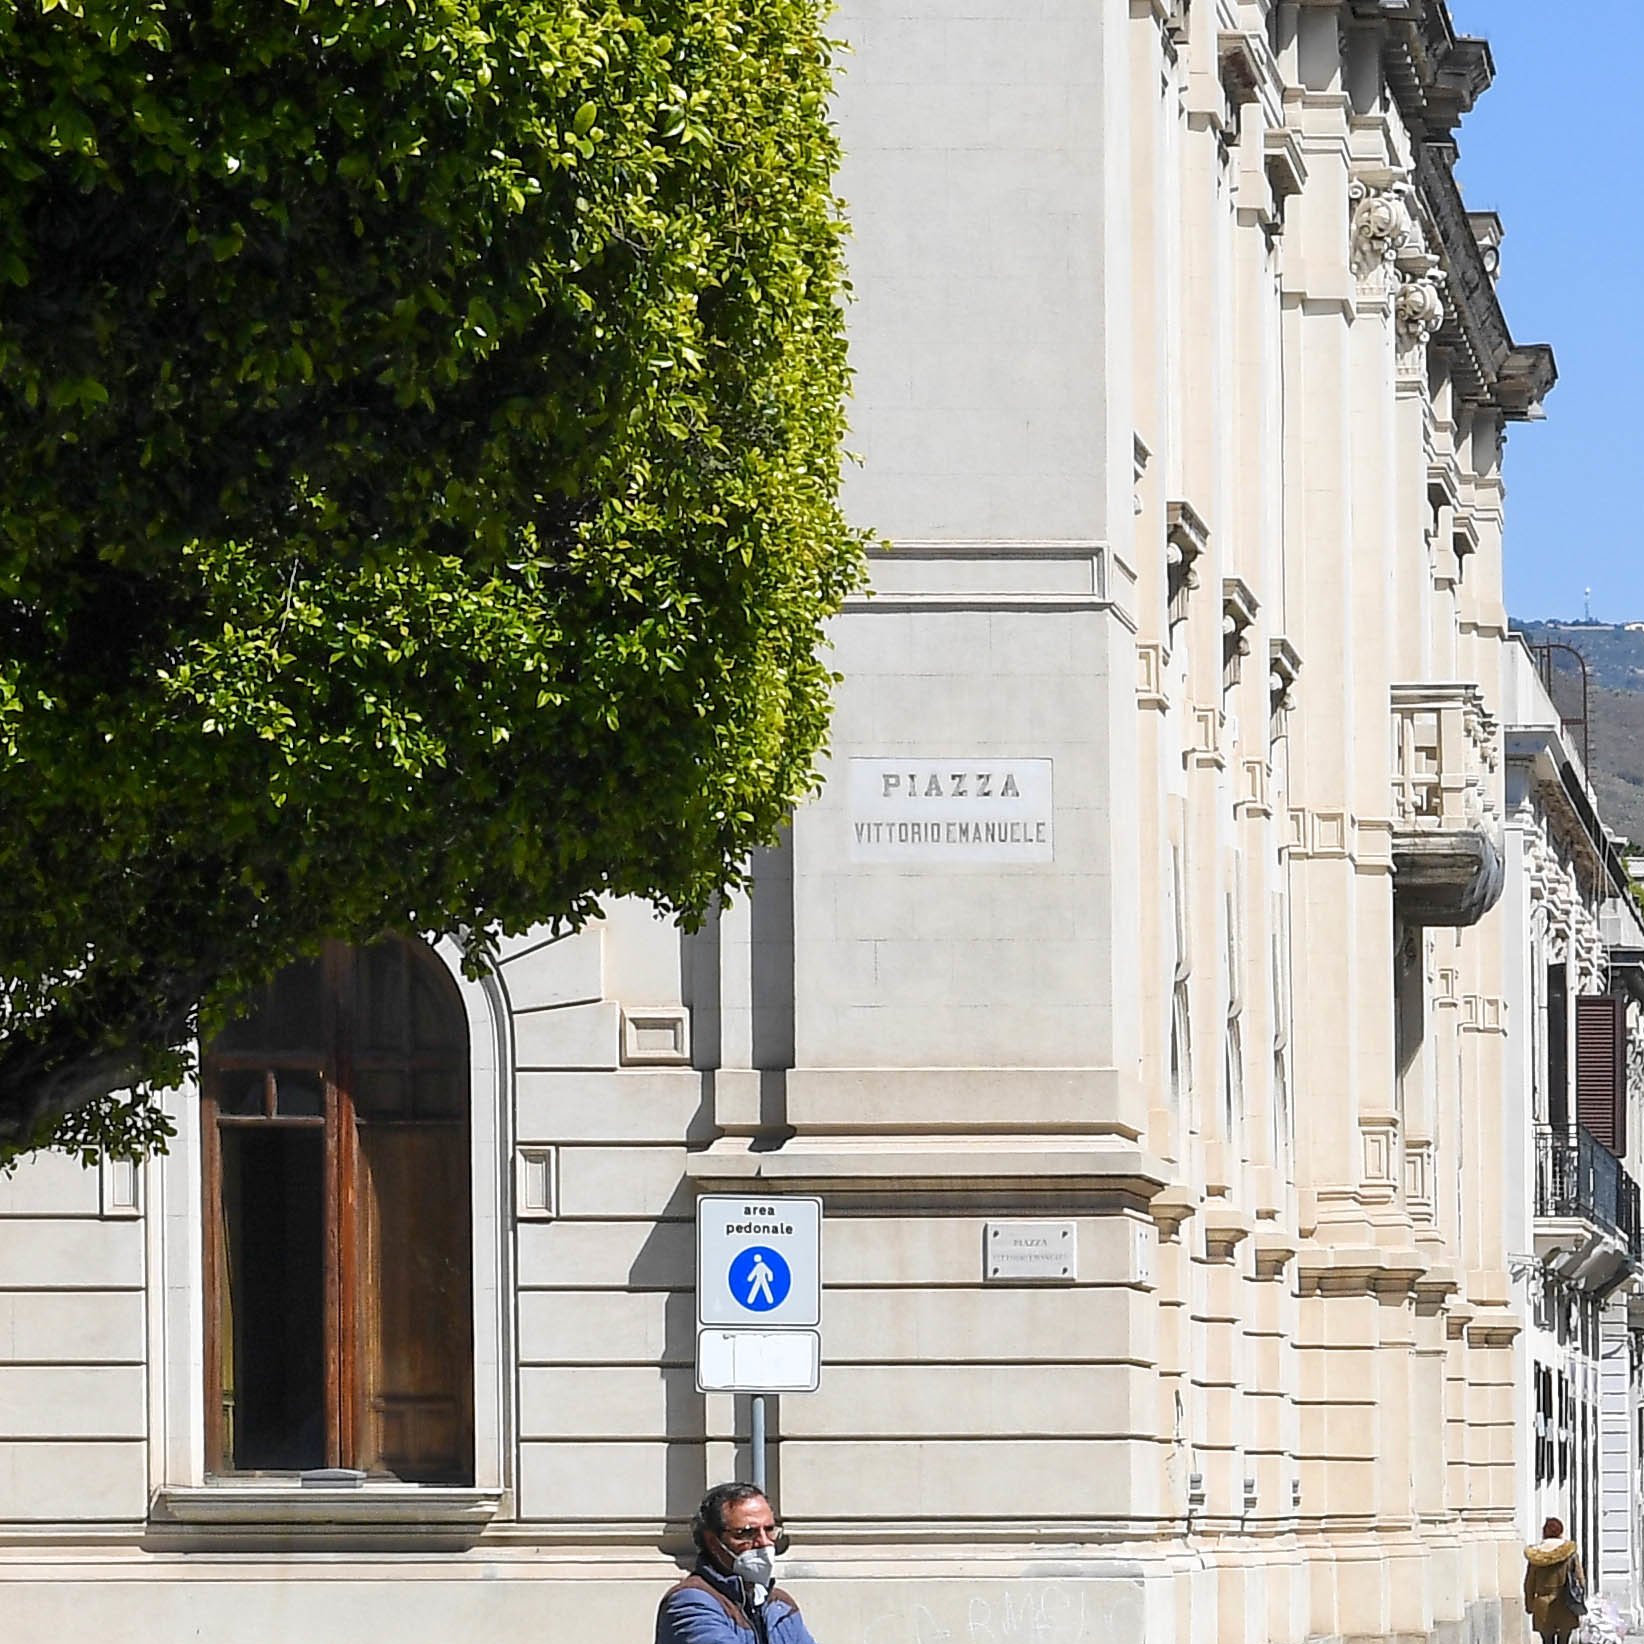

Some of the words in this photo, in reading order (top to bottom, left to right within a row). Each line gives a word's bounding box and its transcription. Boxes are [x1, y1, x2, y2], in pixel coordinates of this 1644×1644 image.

[882, 773, 1020, 798] PIAZZA
[854, 822, 941, 844] VITTORIO
[946, 821, 1047, 844] EMANUELE
[743, 1205, 776, 1217] area
[726, 1222, 794, 1236] pedonale
[1013, 1239, 1048, 1248] PIAZZA
